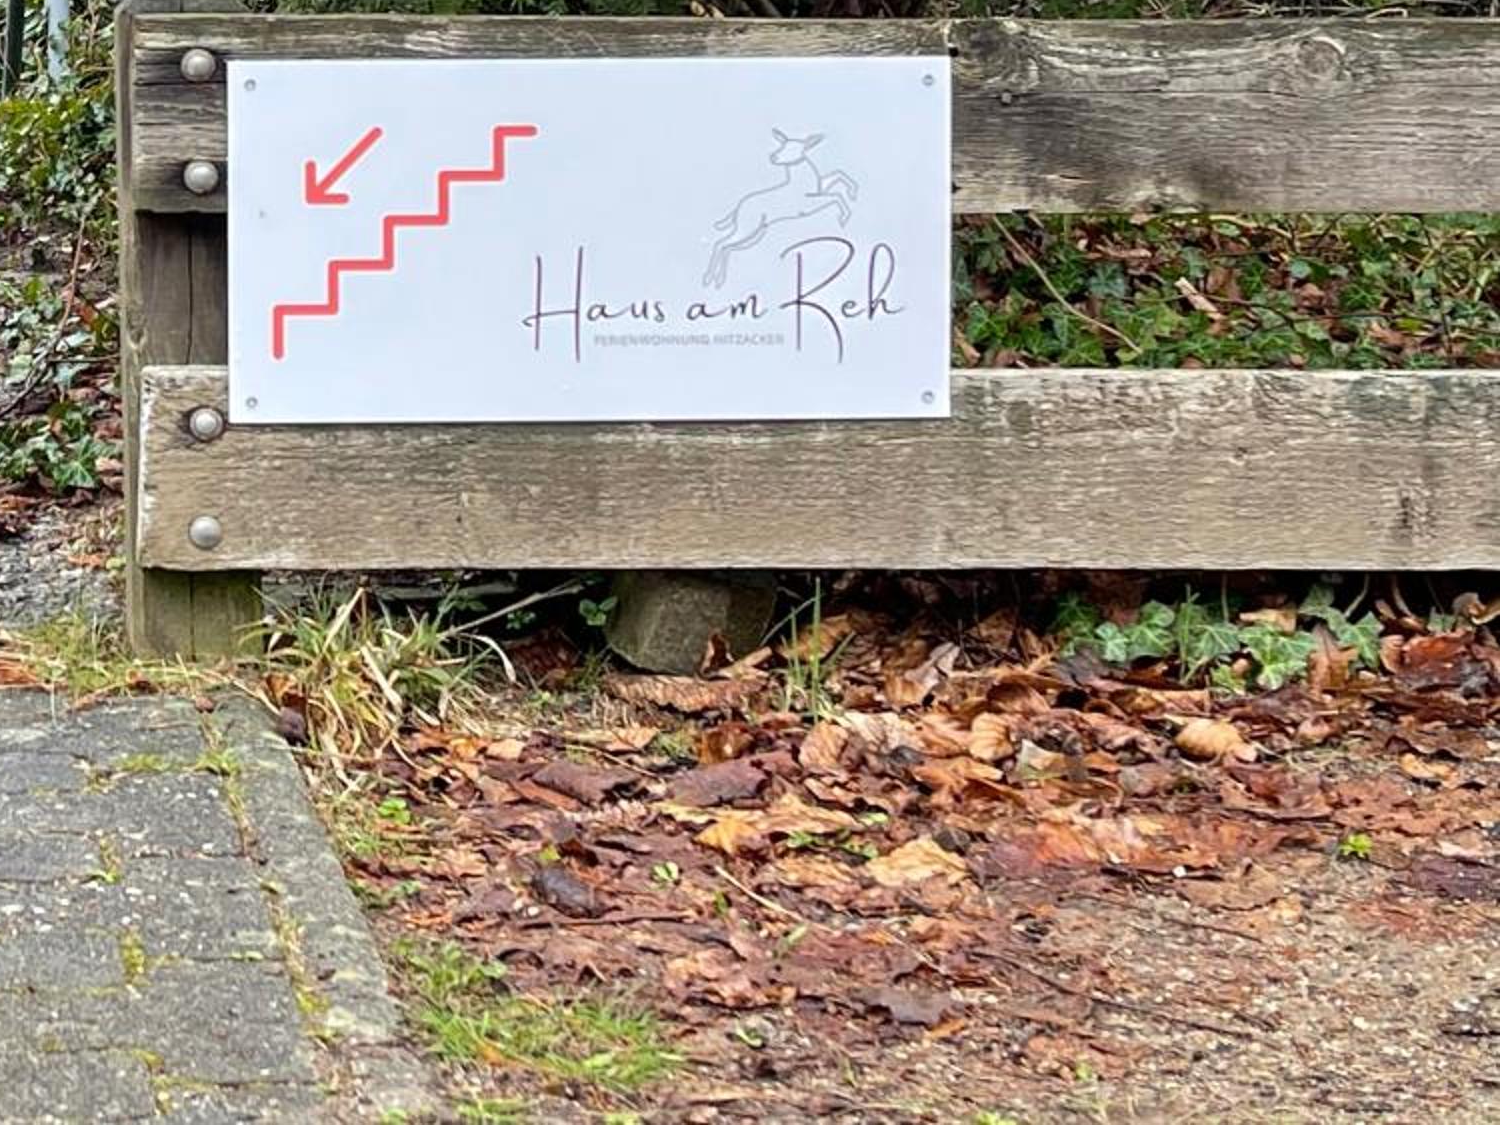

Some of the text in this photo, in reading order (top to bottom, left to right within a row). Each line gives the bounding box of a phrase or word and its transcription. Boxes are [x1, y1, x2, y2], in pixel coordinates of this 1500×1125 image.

[522, 236, 905, 363] Haus am Reh
[593, 333, 710, 347] FERIENWOHNUNG
